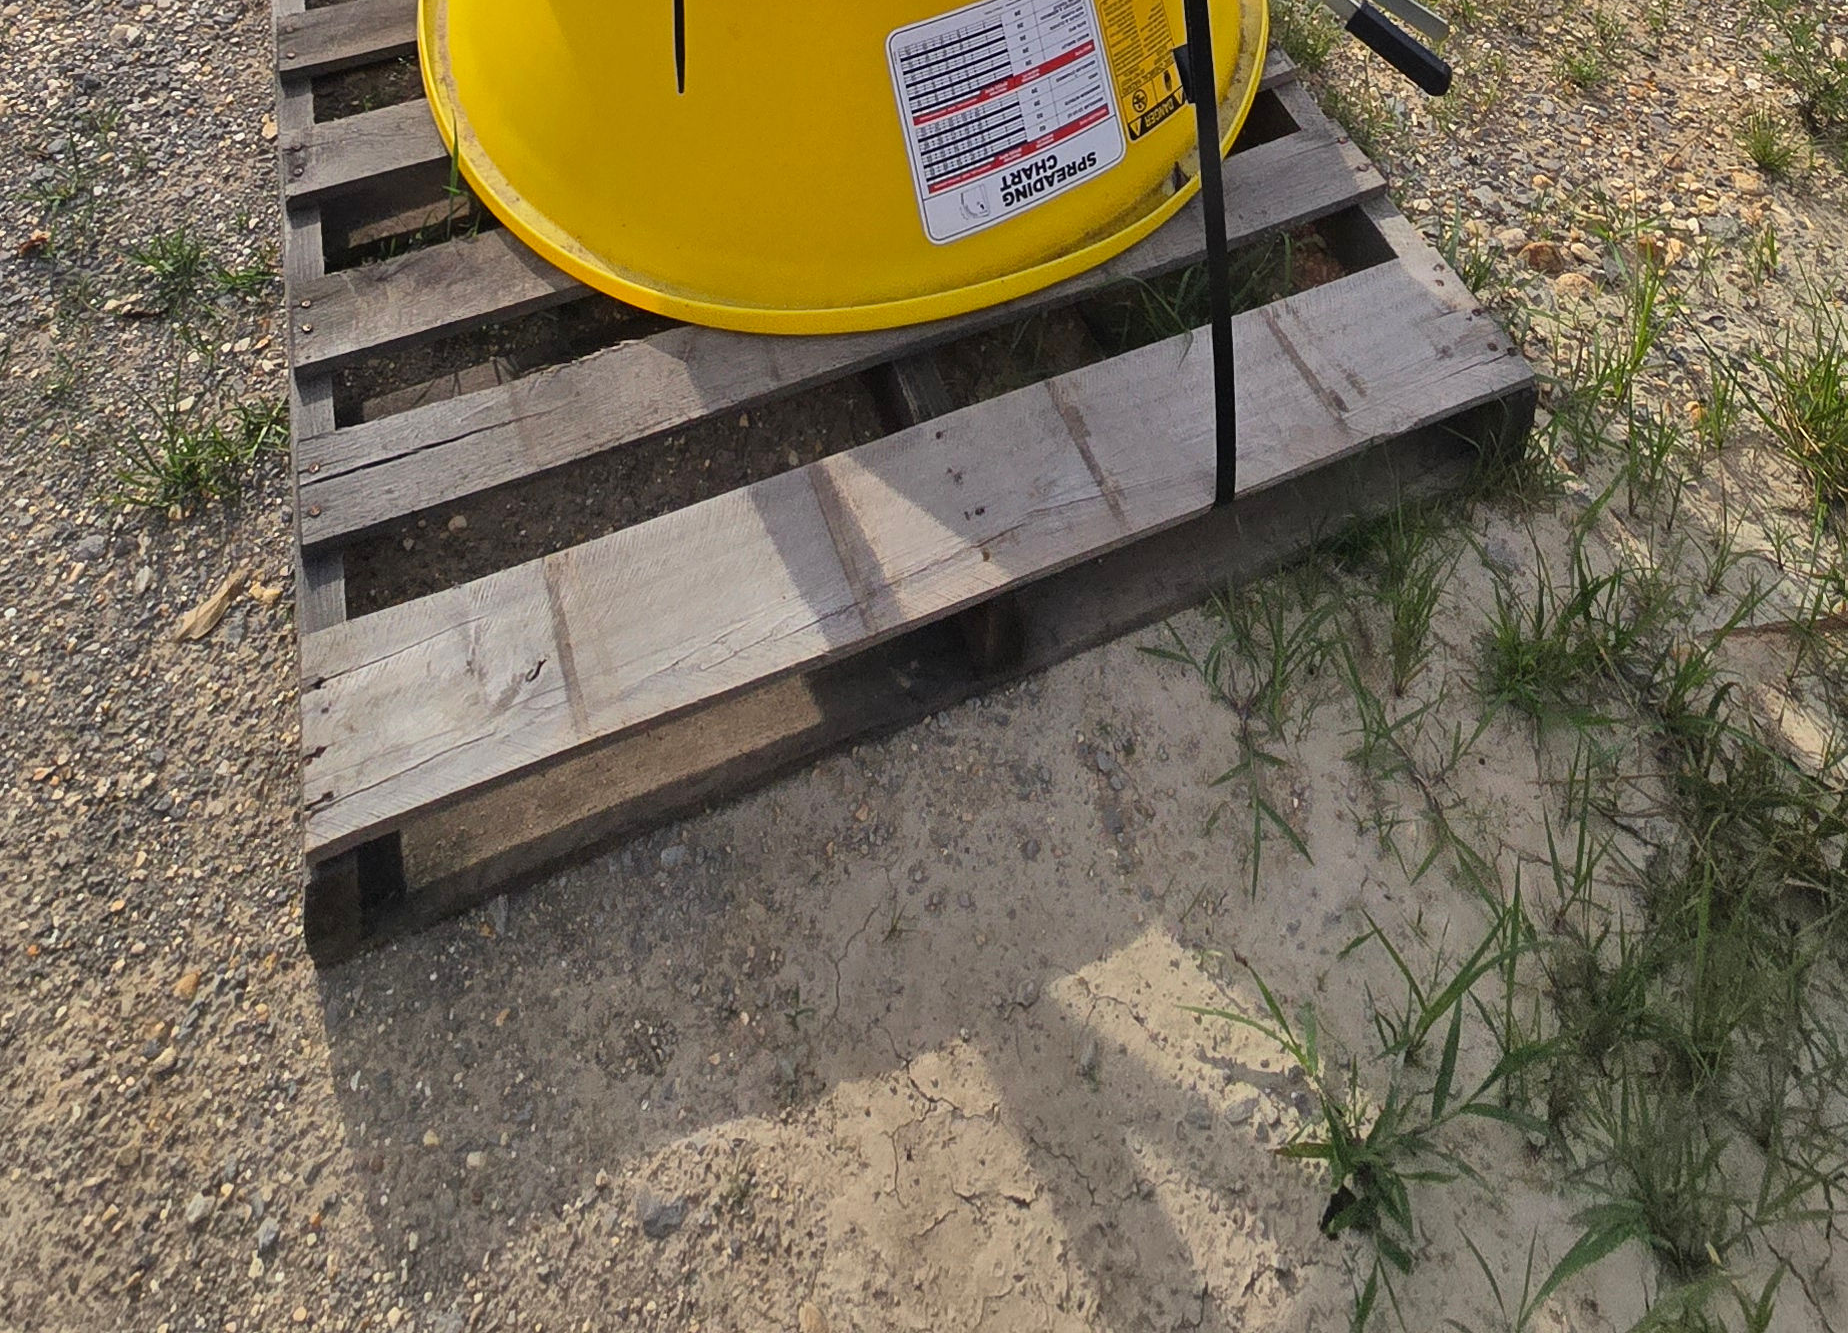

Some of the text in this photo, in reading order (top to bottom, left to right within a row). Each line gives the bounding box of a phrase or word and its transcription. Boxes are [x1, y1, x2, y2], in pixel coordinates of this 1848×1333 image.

[1145, 98, 1174, 127] DANGER
[1000, 154, 1058, 192] CHART
[1002, 151, 1097, 207] SPREADING
